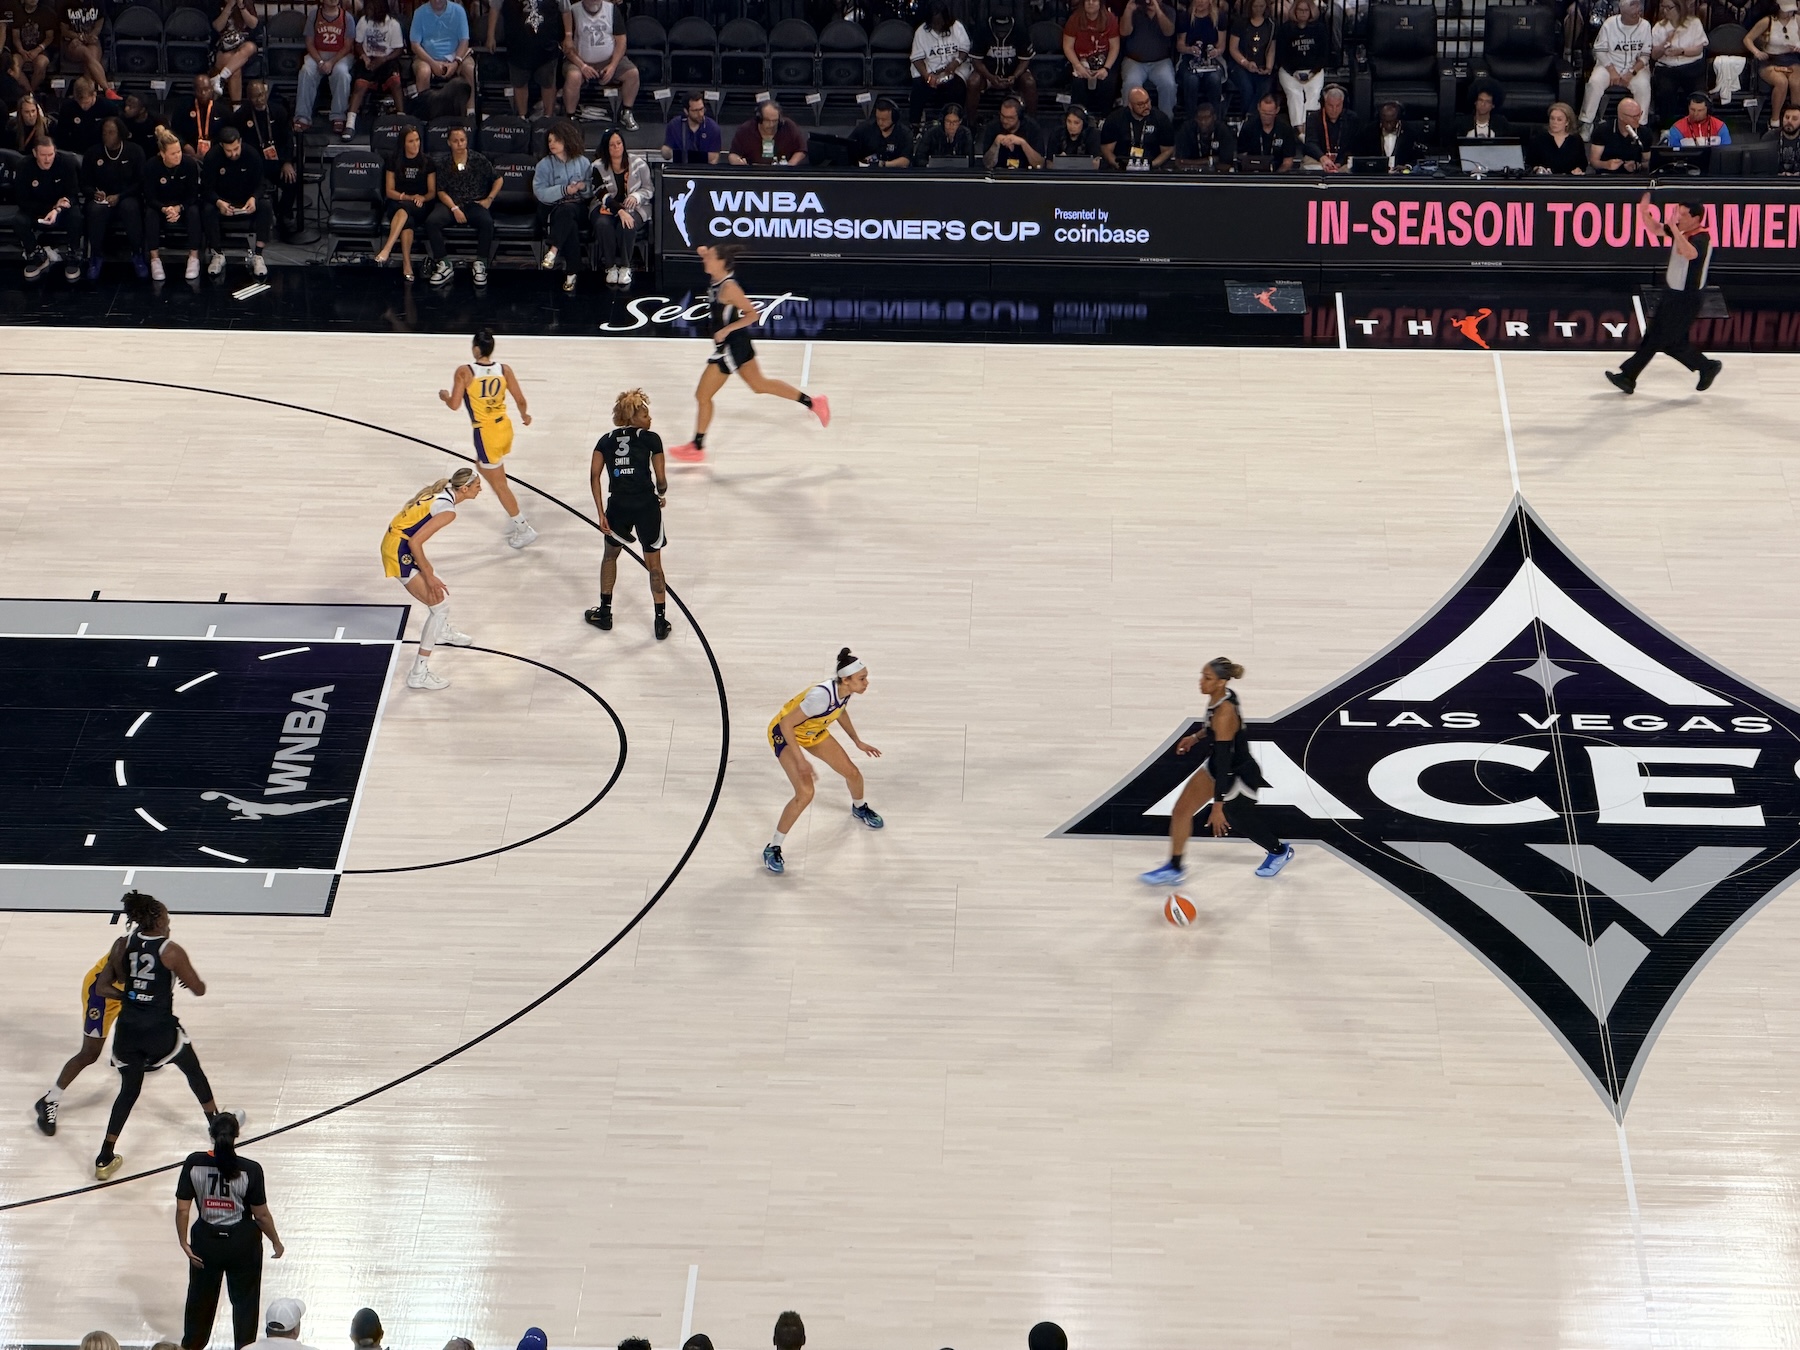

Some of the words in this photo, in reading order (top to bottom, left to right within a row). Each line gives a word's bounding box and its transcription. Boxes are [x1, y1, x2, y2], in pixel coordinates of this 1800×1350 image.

[322, 33, 338, 44] 22
[1614, 43, 1644, 52] ACES
[929, 45, 958, 57] ACES
[709, 190, 824, 213] WNBA
[1054, 207, 1095, 221] Presented
[1098, 208, 1109, 223] by
[1307, 200, 1534, 247] IN-SEASON
[709, 217, 966, 241] COMMISSIONER'S
[970, 220, 1041, 242] CUP
[1054, 223, 1150, 244] coinbase
[479, 377, 501, 398] 10
[614, 436, 631, 457] 3
[614, 457, 630, 466] SMITH
[1339, 710, 1481, 729] LAS
[1518, 713, 1773, 733] VEGAS
[263, 684, 336, 796] WNBA
[1142, 740, 1800, 829] ACE
[129, 952, 156, 980] 12
[208, 1173, 230, 1197] 76
